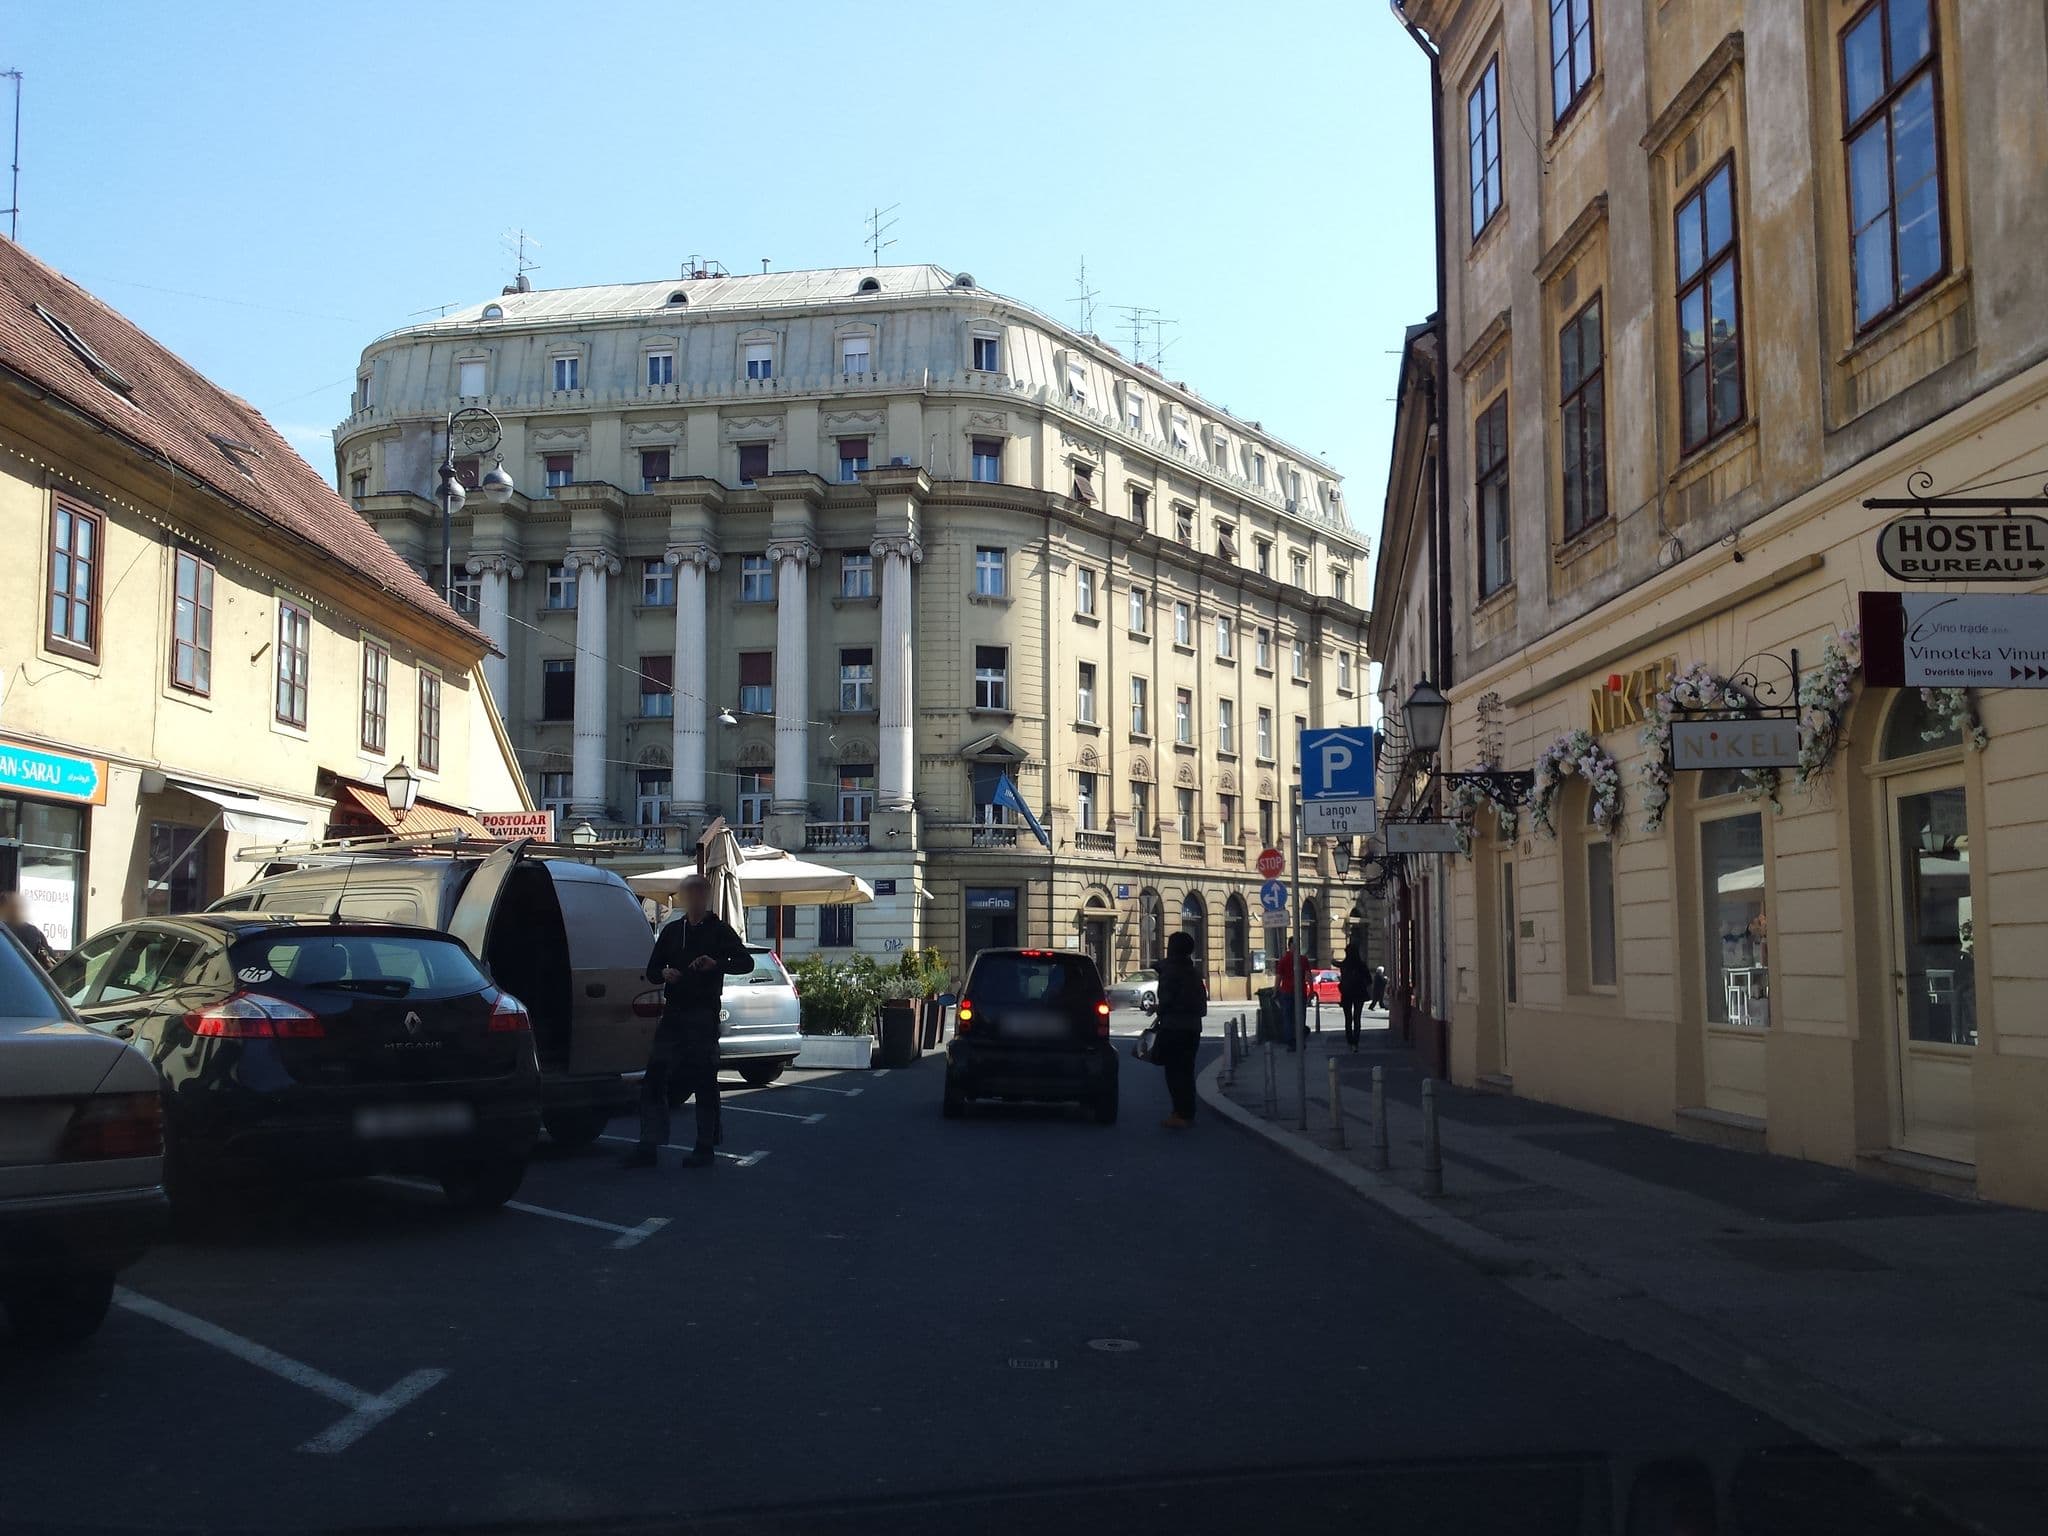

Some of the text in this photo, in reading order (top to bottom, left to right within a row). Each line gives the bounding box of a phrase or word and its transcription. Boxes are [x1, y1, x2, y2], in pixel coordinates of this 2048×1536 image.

[1898, 525, 2045, 552] HOSTEL
[1901, 558, 2023, 572] BUREAU
[1932, 623, 1957, 634] Vino
[1960, 623, 1989, 634] trade
[1910, 646, 1991, 660] Vinoteka
[1924, 667, 1993, 678] Dvorište lijevo
[1322, 746, 1353, 789] P
[1319, 805, 1357, 817] Langov
[483, 815, 546, 826] POSTOLAR
[1331, 820, 1348, 832] trg
[1259, 857, 1282, 870] STOP
[988, 897, 1010, 908] Fina
